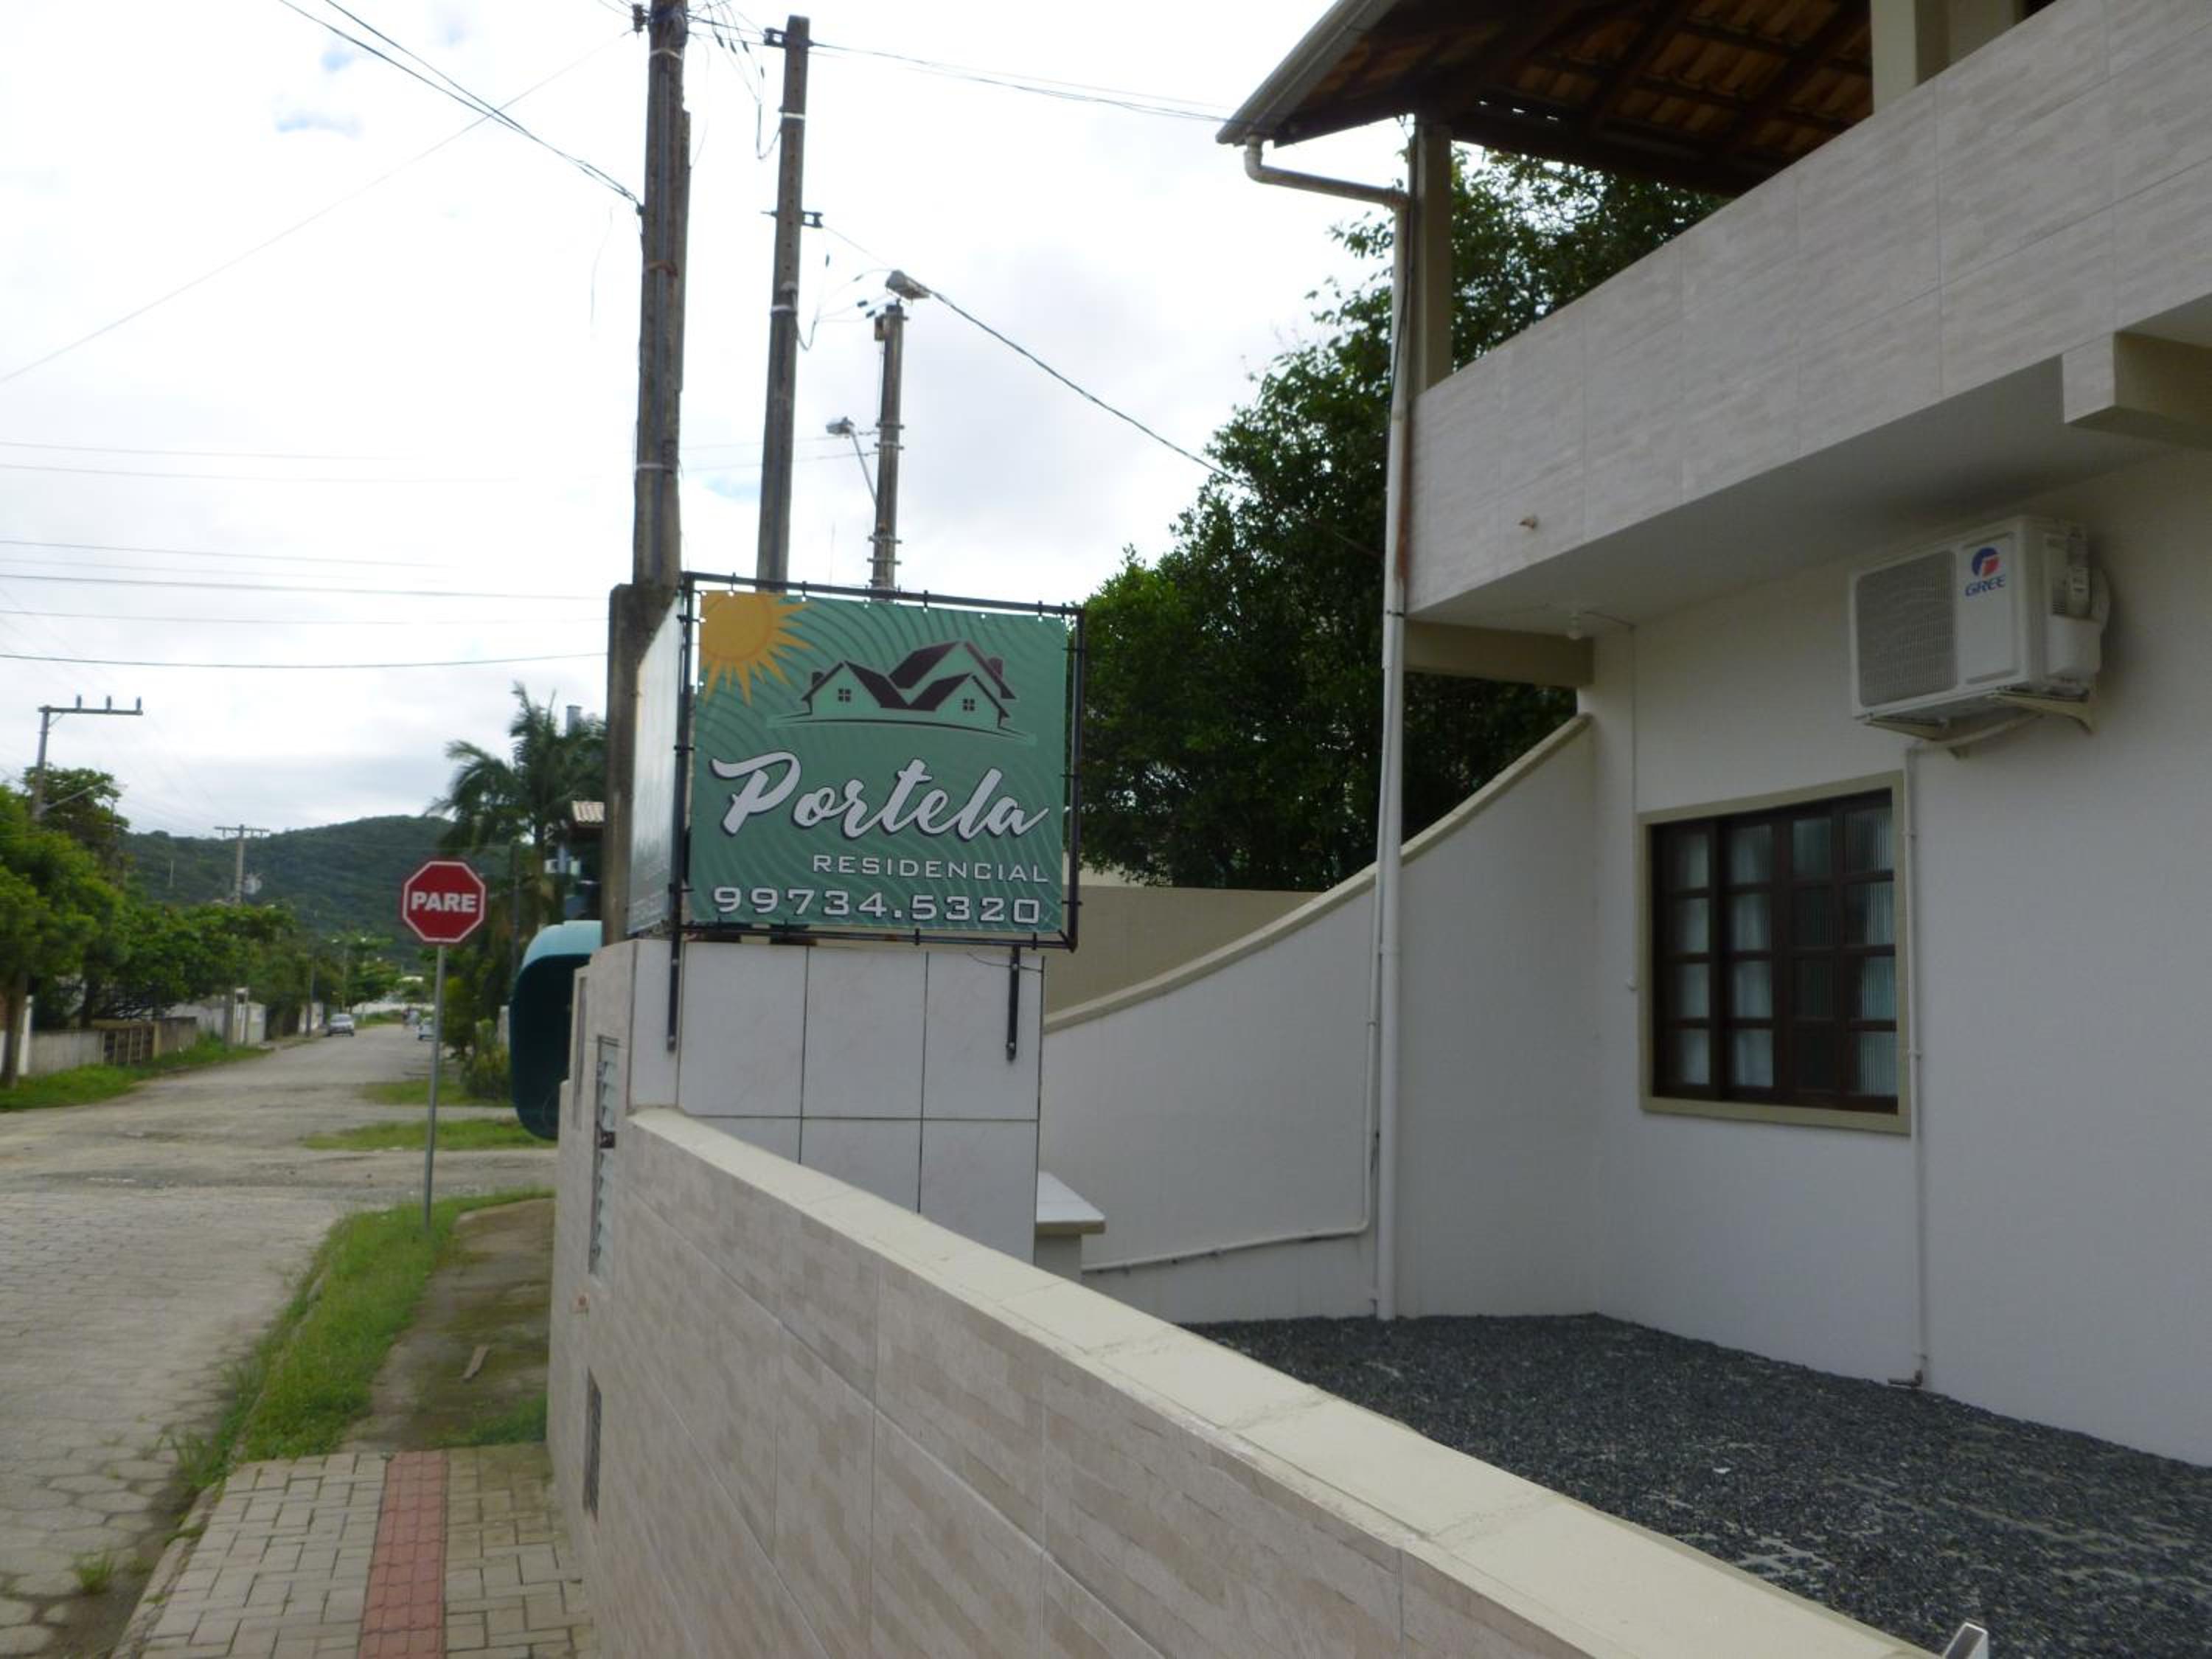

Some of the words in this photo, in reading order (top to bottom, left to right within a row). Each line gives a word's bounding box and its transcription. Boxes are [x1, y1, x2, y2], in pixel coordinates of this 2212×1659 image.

[1965, 575, 2006, 597] GREE
[711, 751, 1050, 840] Portela
[813, 855, 1050, 883] RESIDENCIAL
[411, 891, 478, 913] PARE
[712, 887, 1042, 924] 99734.5320
